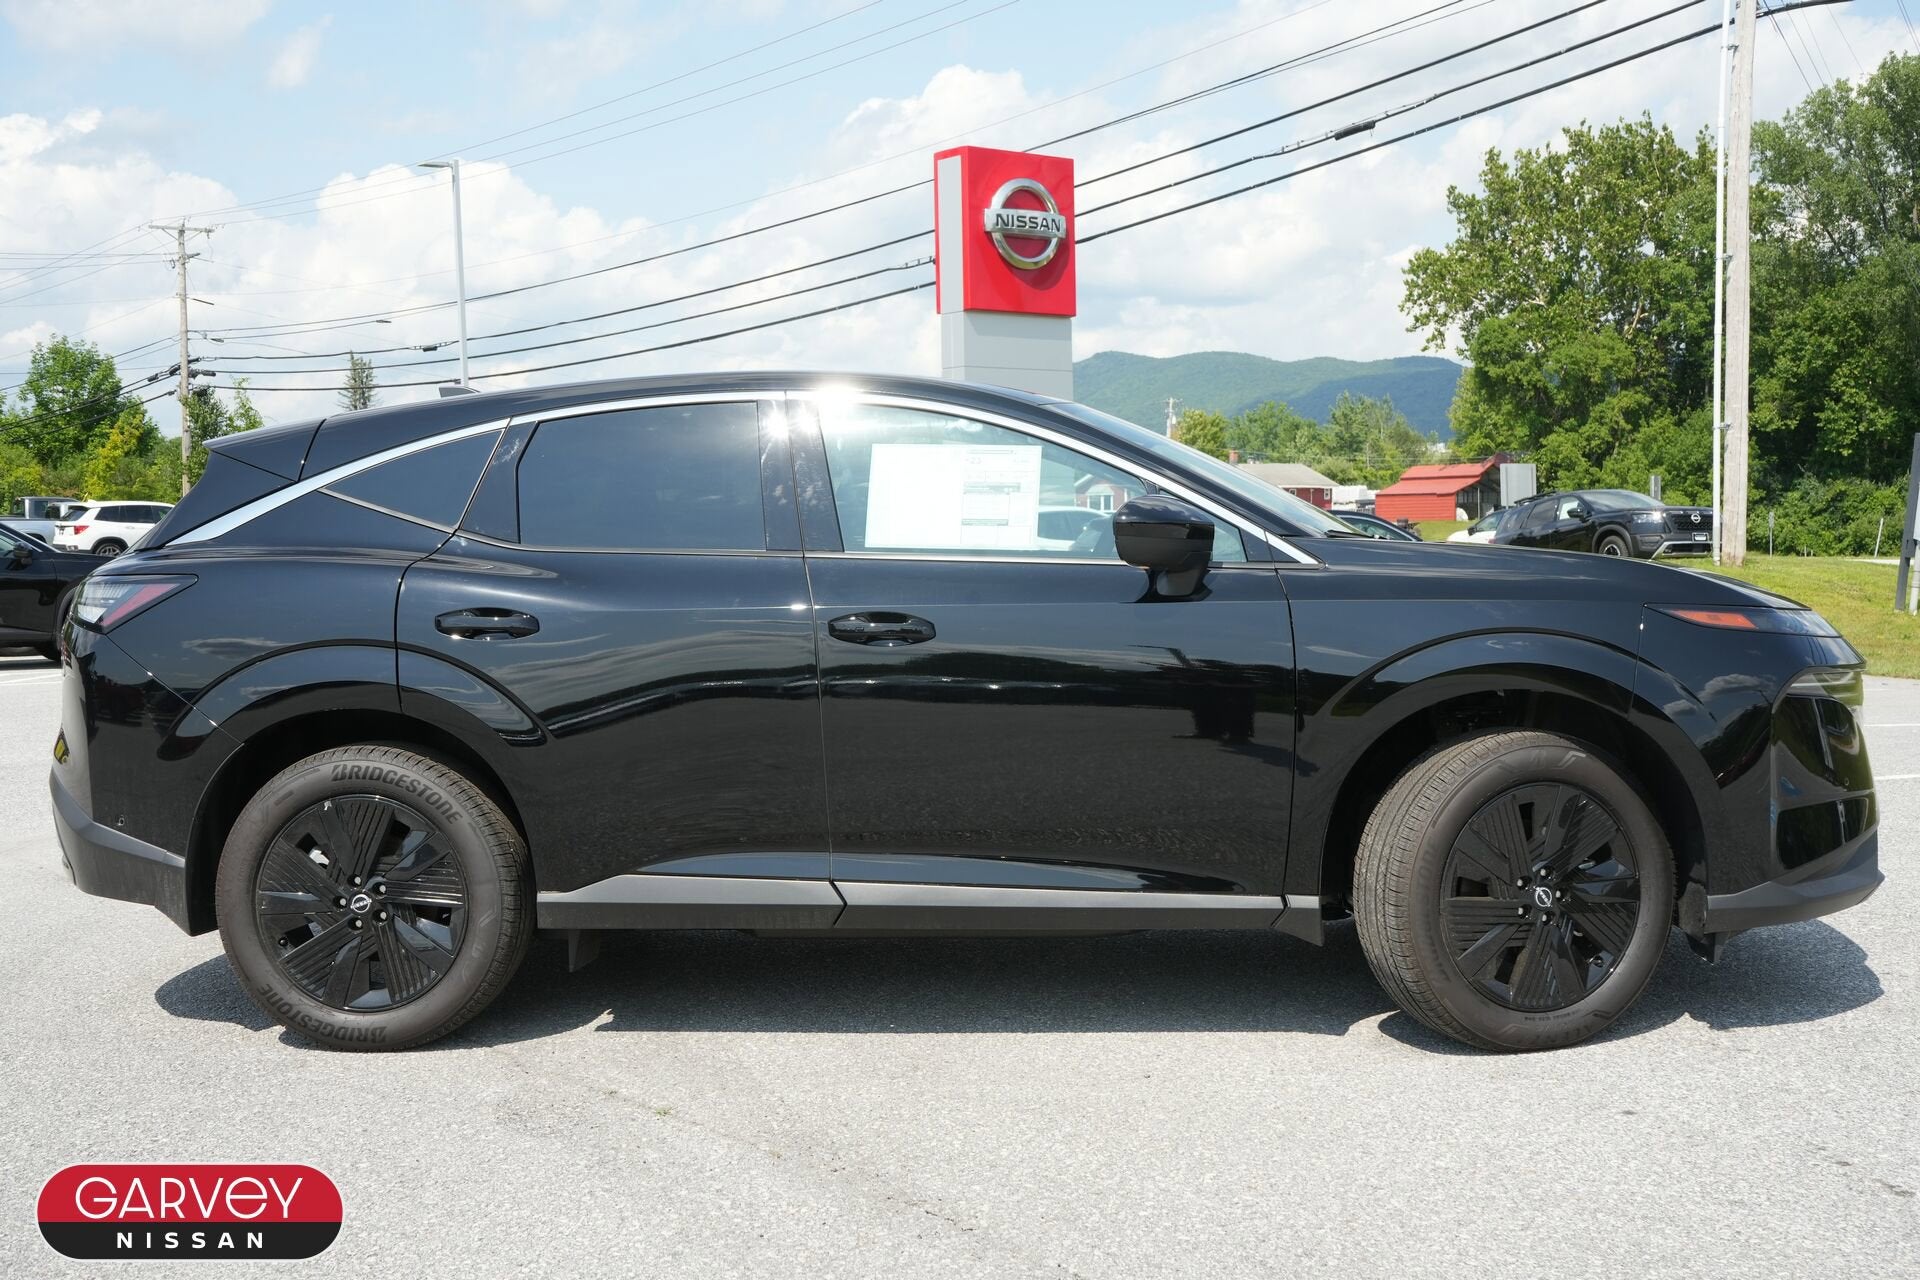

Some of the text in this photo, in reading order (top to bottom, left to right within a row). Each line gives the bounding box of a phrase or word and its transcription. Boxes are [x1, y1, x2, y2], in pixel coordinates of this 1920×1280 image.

[995, 213, 1062, 233] NISSAN
[331, 763, 463, 825] BRIDGESTONE
[257, 984, 388, 1044] BRIDGESTONE
